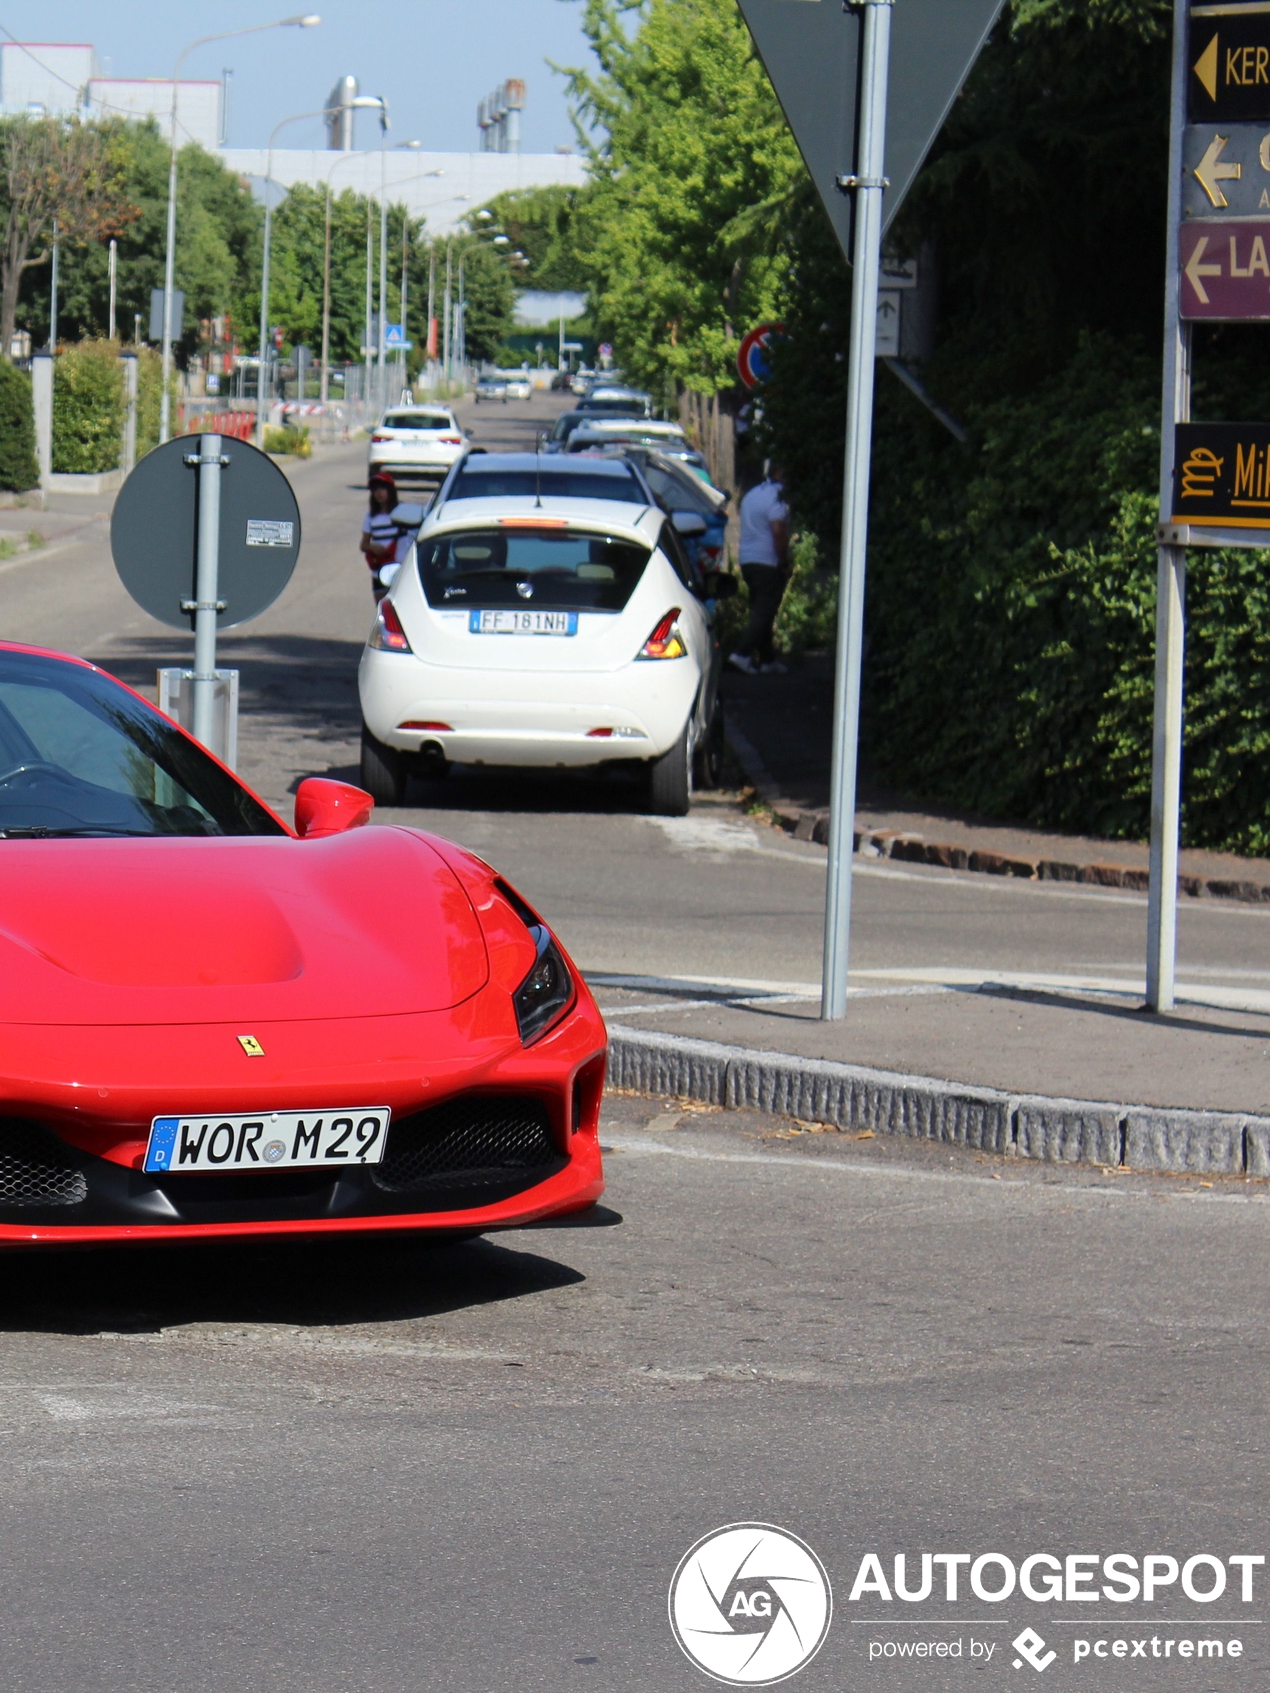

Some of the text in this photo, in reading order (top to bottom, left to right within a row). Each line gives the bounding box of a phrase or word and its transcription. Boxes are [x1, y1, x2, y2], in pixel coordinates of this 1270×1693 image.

[1234, 442, 1270, 498] Mi
[482, 611, 566, 630] FF 181NH
[154, 1150, 166, 1163] D
[178, 1116, 381, 1164] WOR M29
